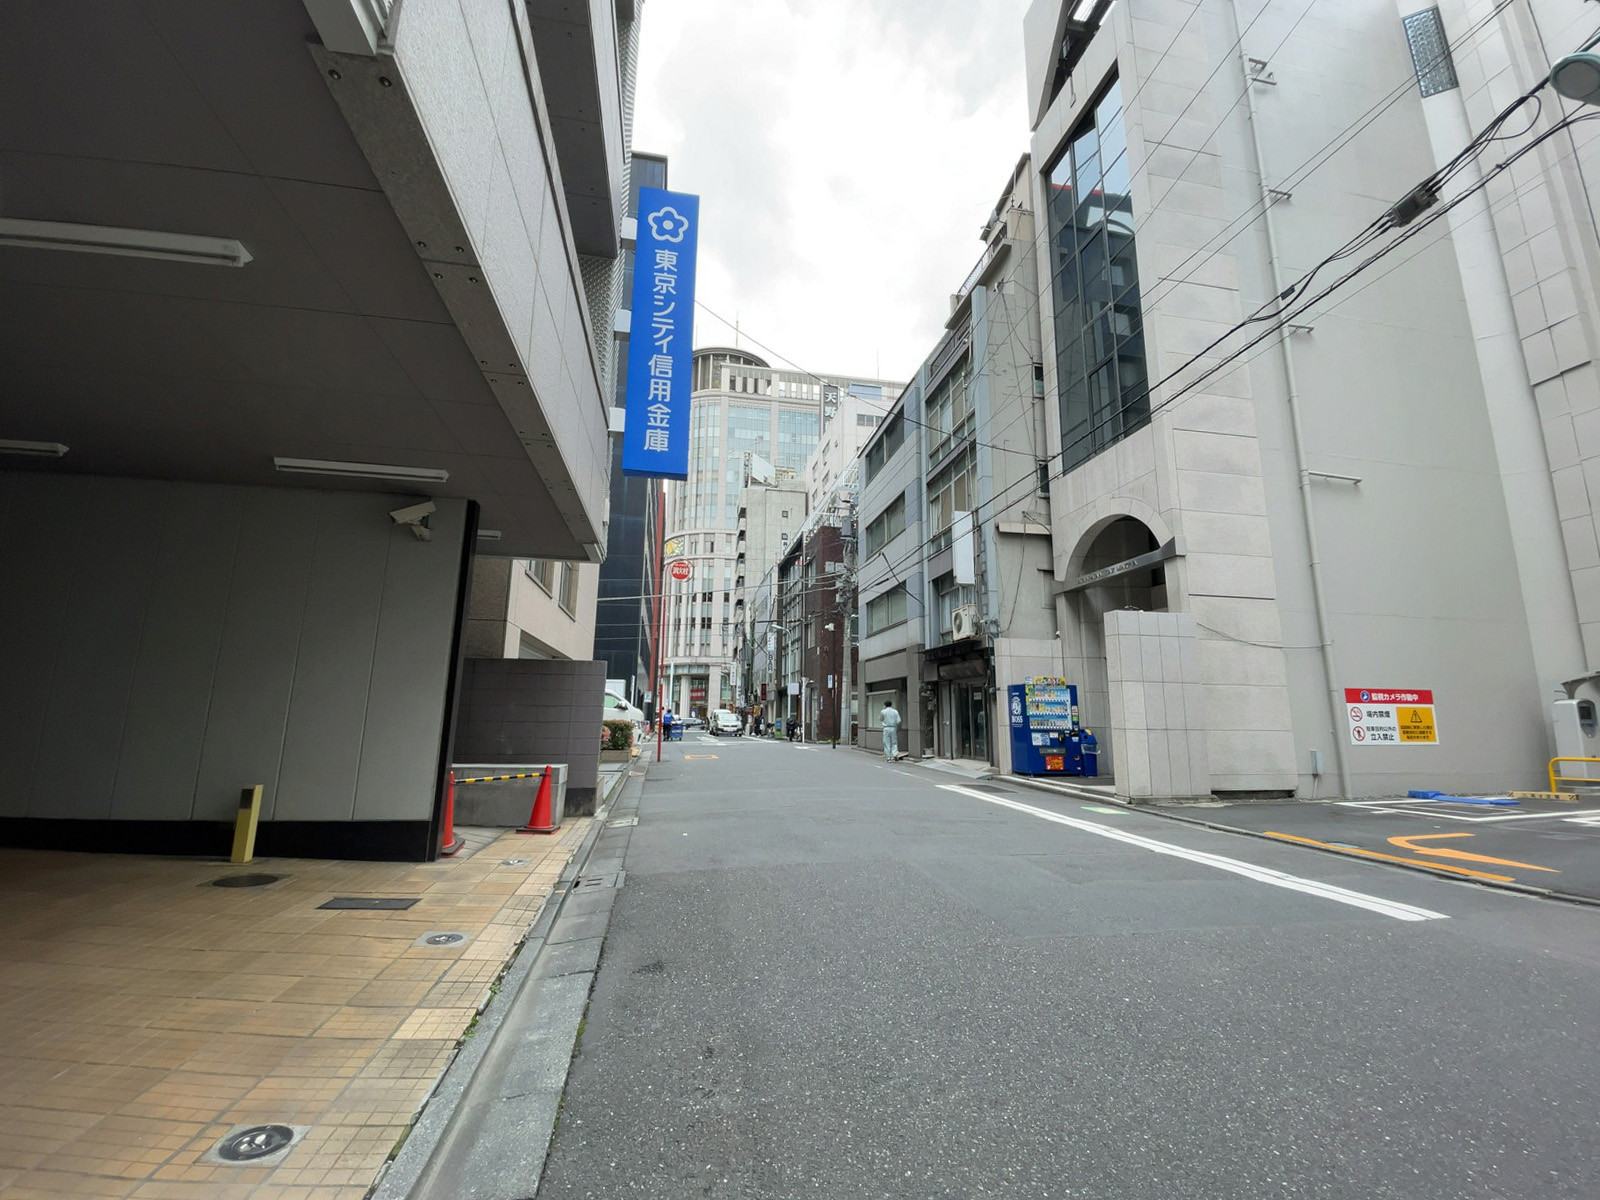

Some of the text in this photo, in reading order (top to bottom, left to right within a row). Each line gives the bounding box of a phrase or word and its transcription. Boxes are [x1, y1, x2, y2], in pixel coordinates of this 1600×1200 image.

[643, 249, 678, 452] 東京シティ信用金庫
[1371, 692, 1419, 702] 監視カメラ作動中
[1366, 710, 1391, 718] 場内禁煙
[1011, 715, 1023, 724] BOSS
[1371, 733, 1395, 741] 立入禁止
